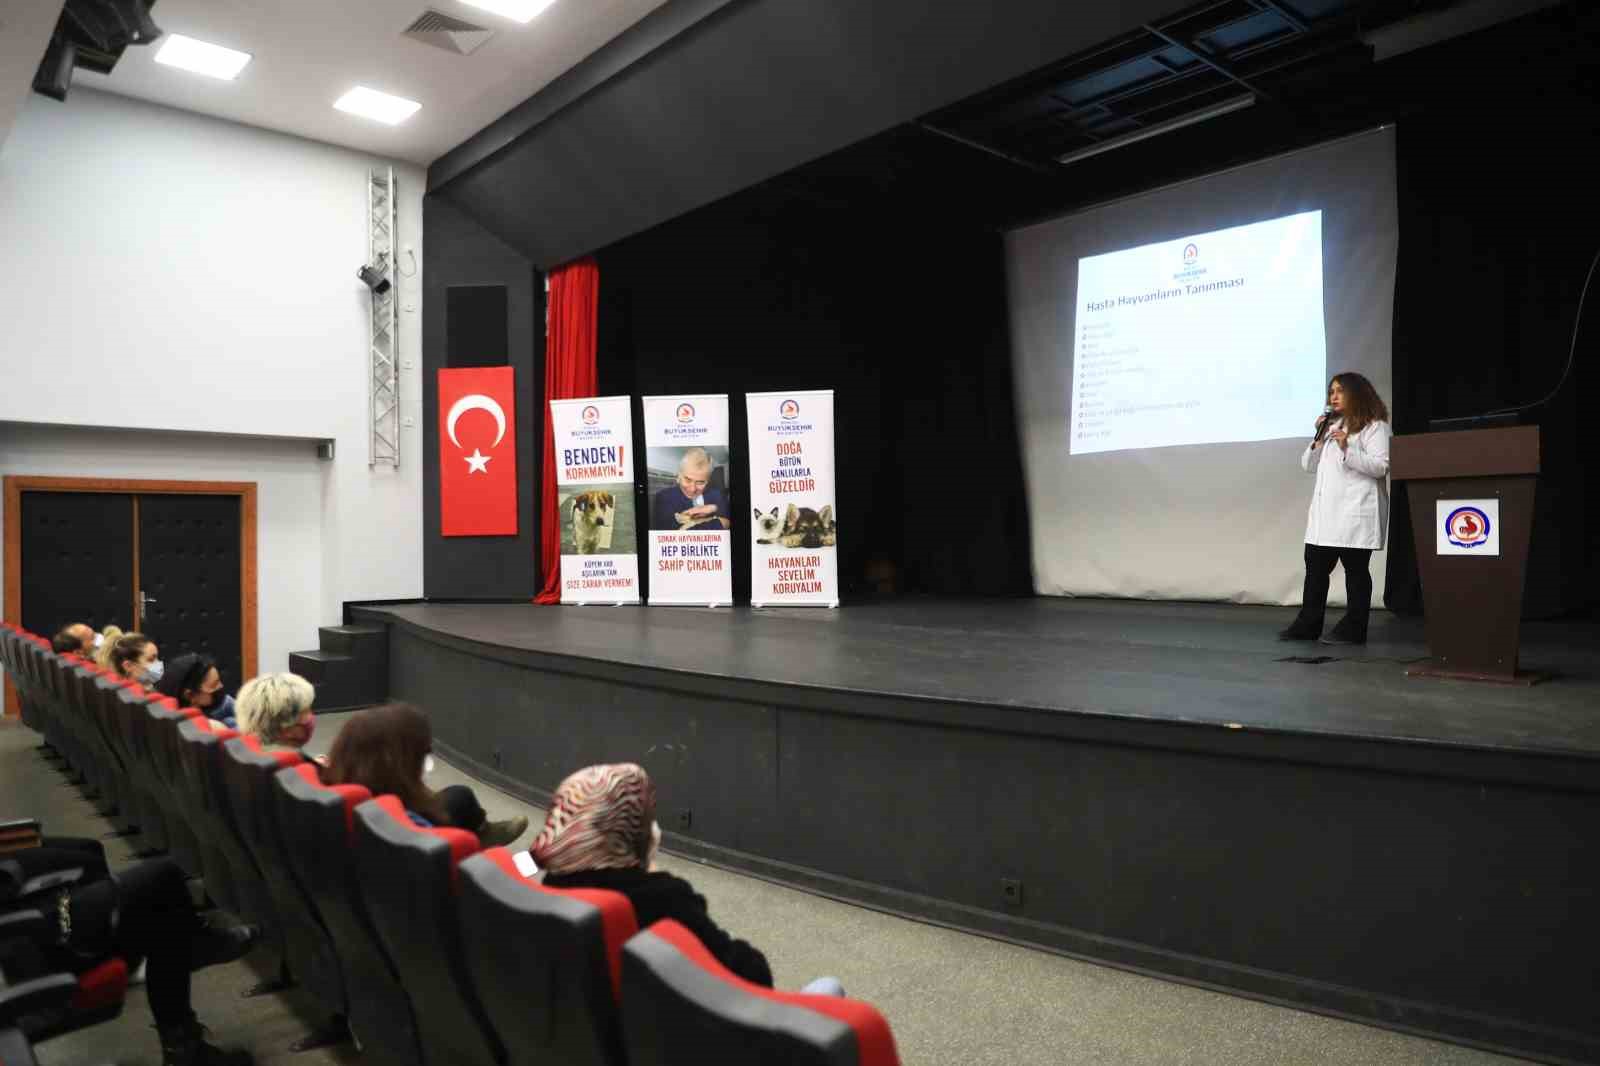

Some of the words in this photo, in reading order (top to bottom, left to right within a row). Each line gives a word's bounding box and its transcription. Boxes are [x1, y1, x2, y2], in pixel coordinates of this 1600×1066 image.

[1086, 299, 1115, 313] Hasta
[776, 440, 802, 455] DOĞA
[564, 446, 616, 466] BENDEN
[779, 456, 802, 467] BÜTÜN
[565, 465, 617, 480] KORKMAYIN
[770, 467, 812, 479] CANLILARLA
[768, 478, 816, 494] GÜZELDİR
[661, 545, 679, 557] HEP
[681, 543, 720, 557] BİRLİKTE
[658, 558, 684, 571] SAHİP
[768, 556, 821, 569] HAYVANLARI
[777, 567, 816, 582] SEVELİM
[772, 581, 823, 595] KORUYALIM
